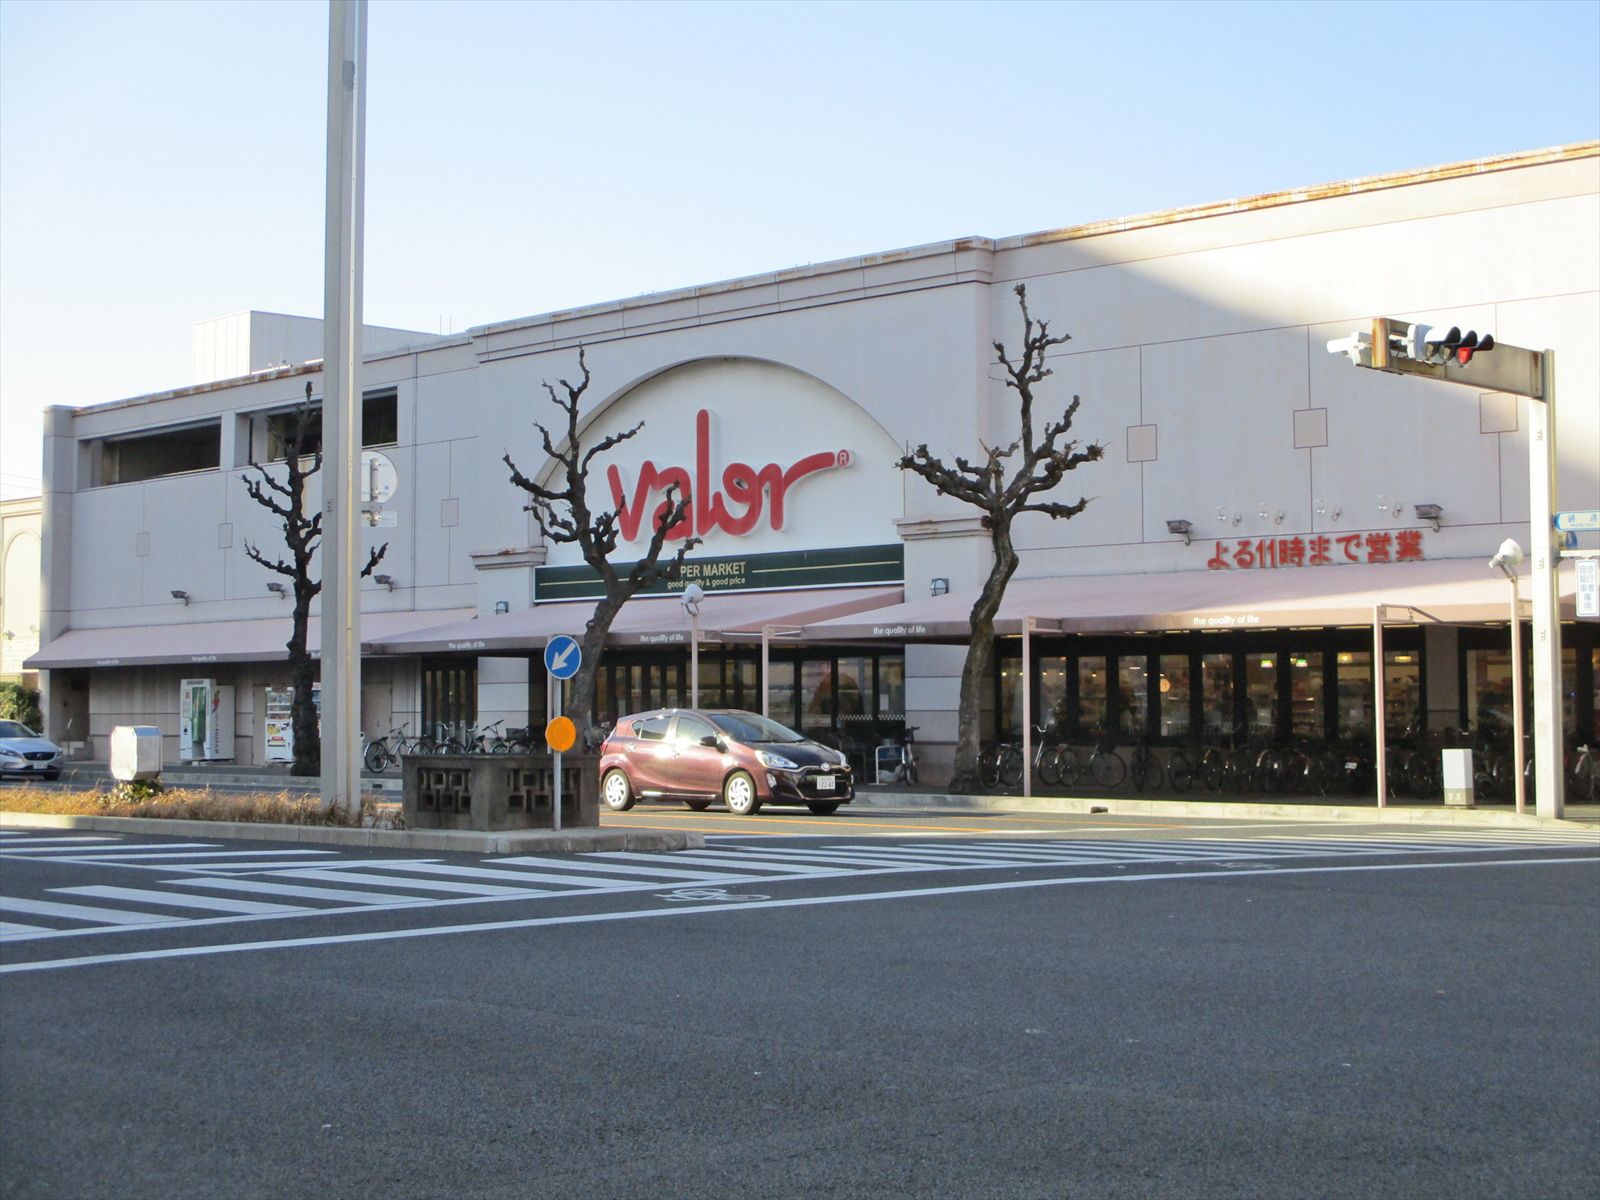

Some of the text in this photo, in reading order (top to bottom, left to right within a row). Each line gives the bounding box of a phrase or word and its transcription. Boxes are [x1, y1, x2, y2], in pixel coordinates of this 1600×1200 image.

[1207, 529, 1425, 571] よる11時まで営業
[703, 562, 746, 577] MARKET
[667, 580, 683, 589] good
[711, 577, 729, 587] good
[729, 576, 746, 586] price
[1208, 615, 1235, 626] quality
[1237, 615, 1245, 624] of
[1247, 614, 1259, 624] life
[873, 625, 926, 636] the quality of life
[650, 634, 668, 643] quality
